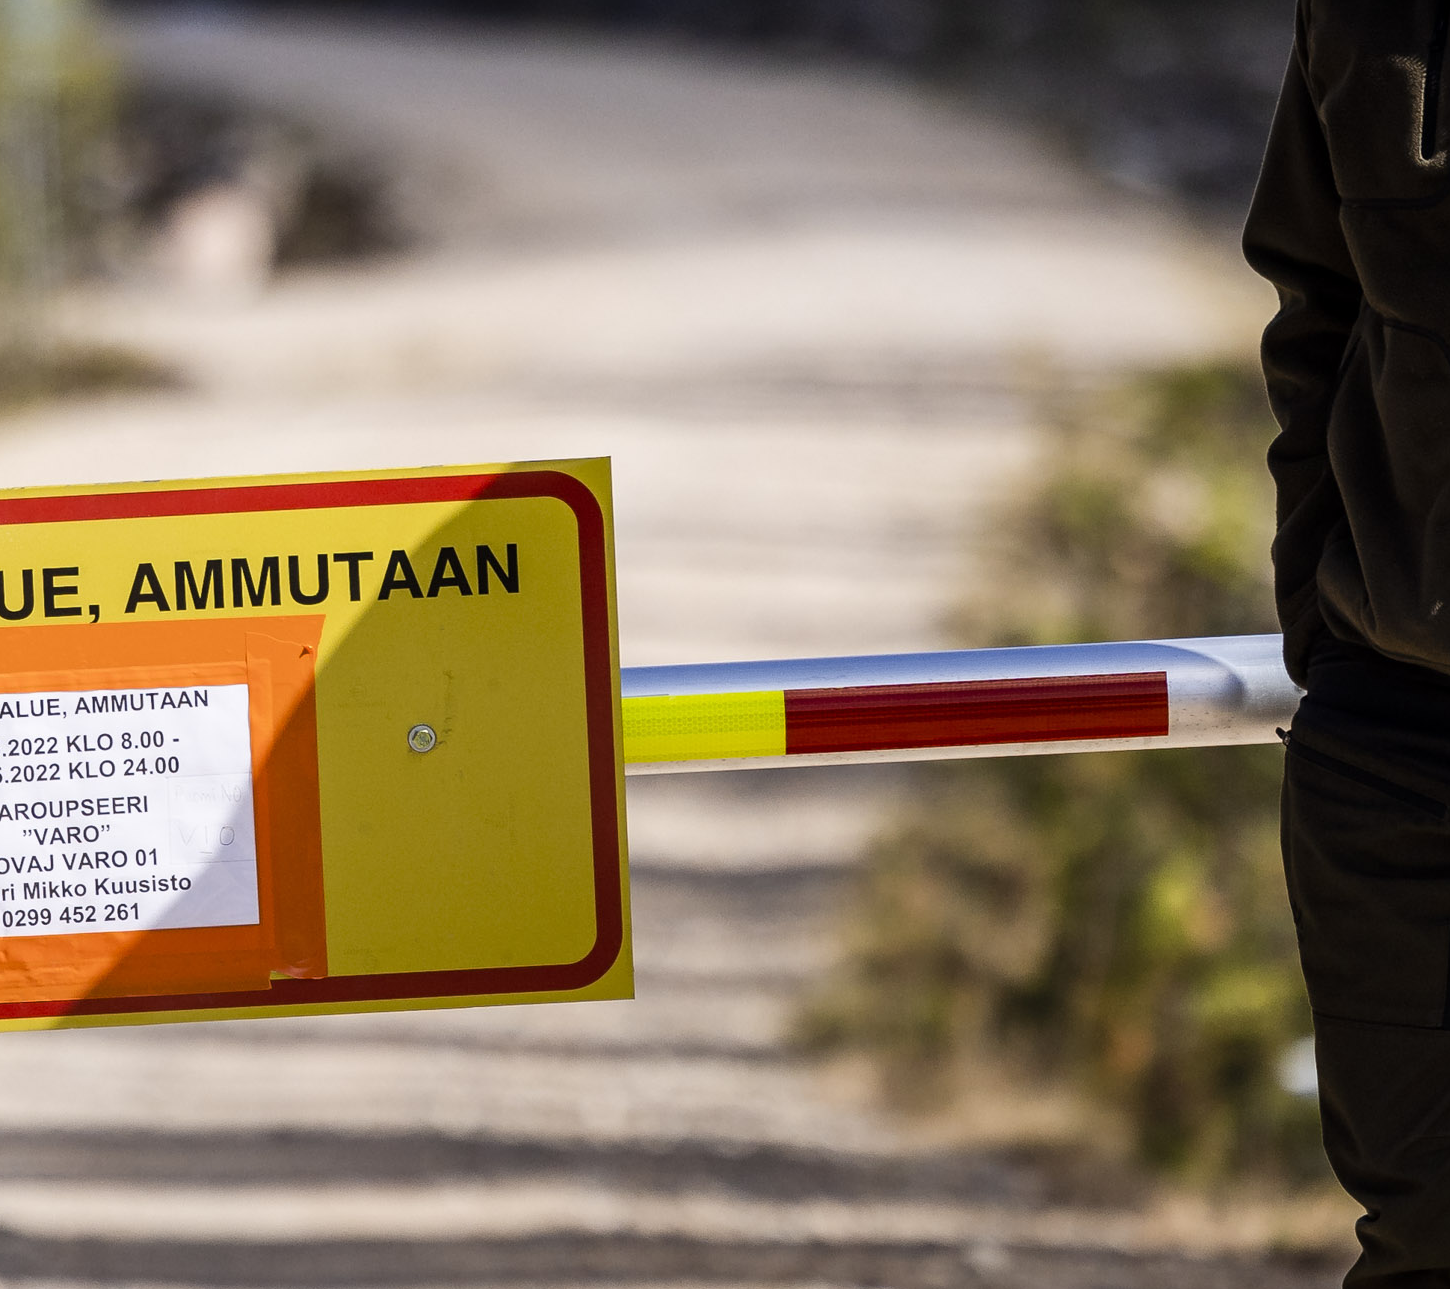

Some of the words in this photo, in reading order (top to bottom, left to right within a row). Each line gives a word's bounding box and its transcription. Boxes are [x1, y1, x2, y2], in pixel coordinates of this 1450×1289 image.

[124, 543, 520, 614] AMMUTAAN
[74, 689, 208, 715] AMMUTAAN
[66, 733, 113, 753] KLO
[121, 730, 164, 750] 8.00
[69, 760, 116, 780] KLO
[123, 756, 180, 776] 24.00
[61, 851, 128, 871] VARO
[135, 848, 157, 867] 01
[23, 879, 87, 900] Mikko
[94, 874, 192, 896] Kuusisto
[2, 908, 52, 928] 0299
[59, 905, 97, 924] 452
[104, 902, 139, 922] 261
